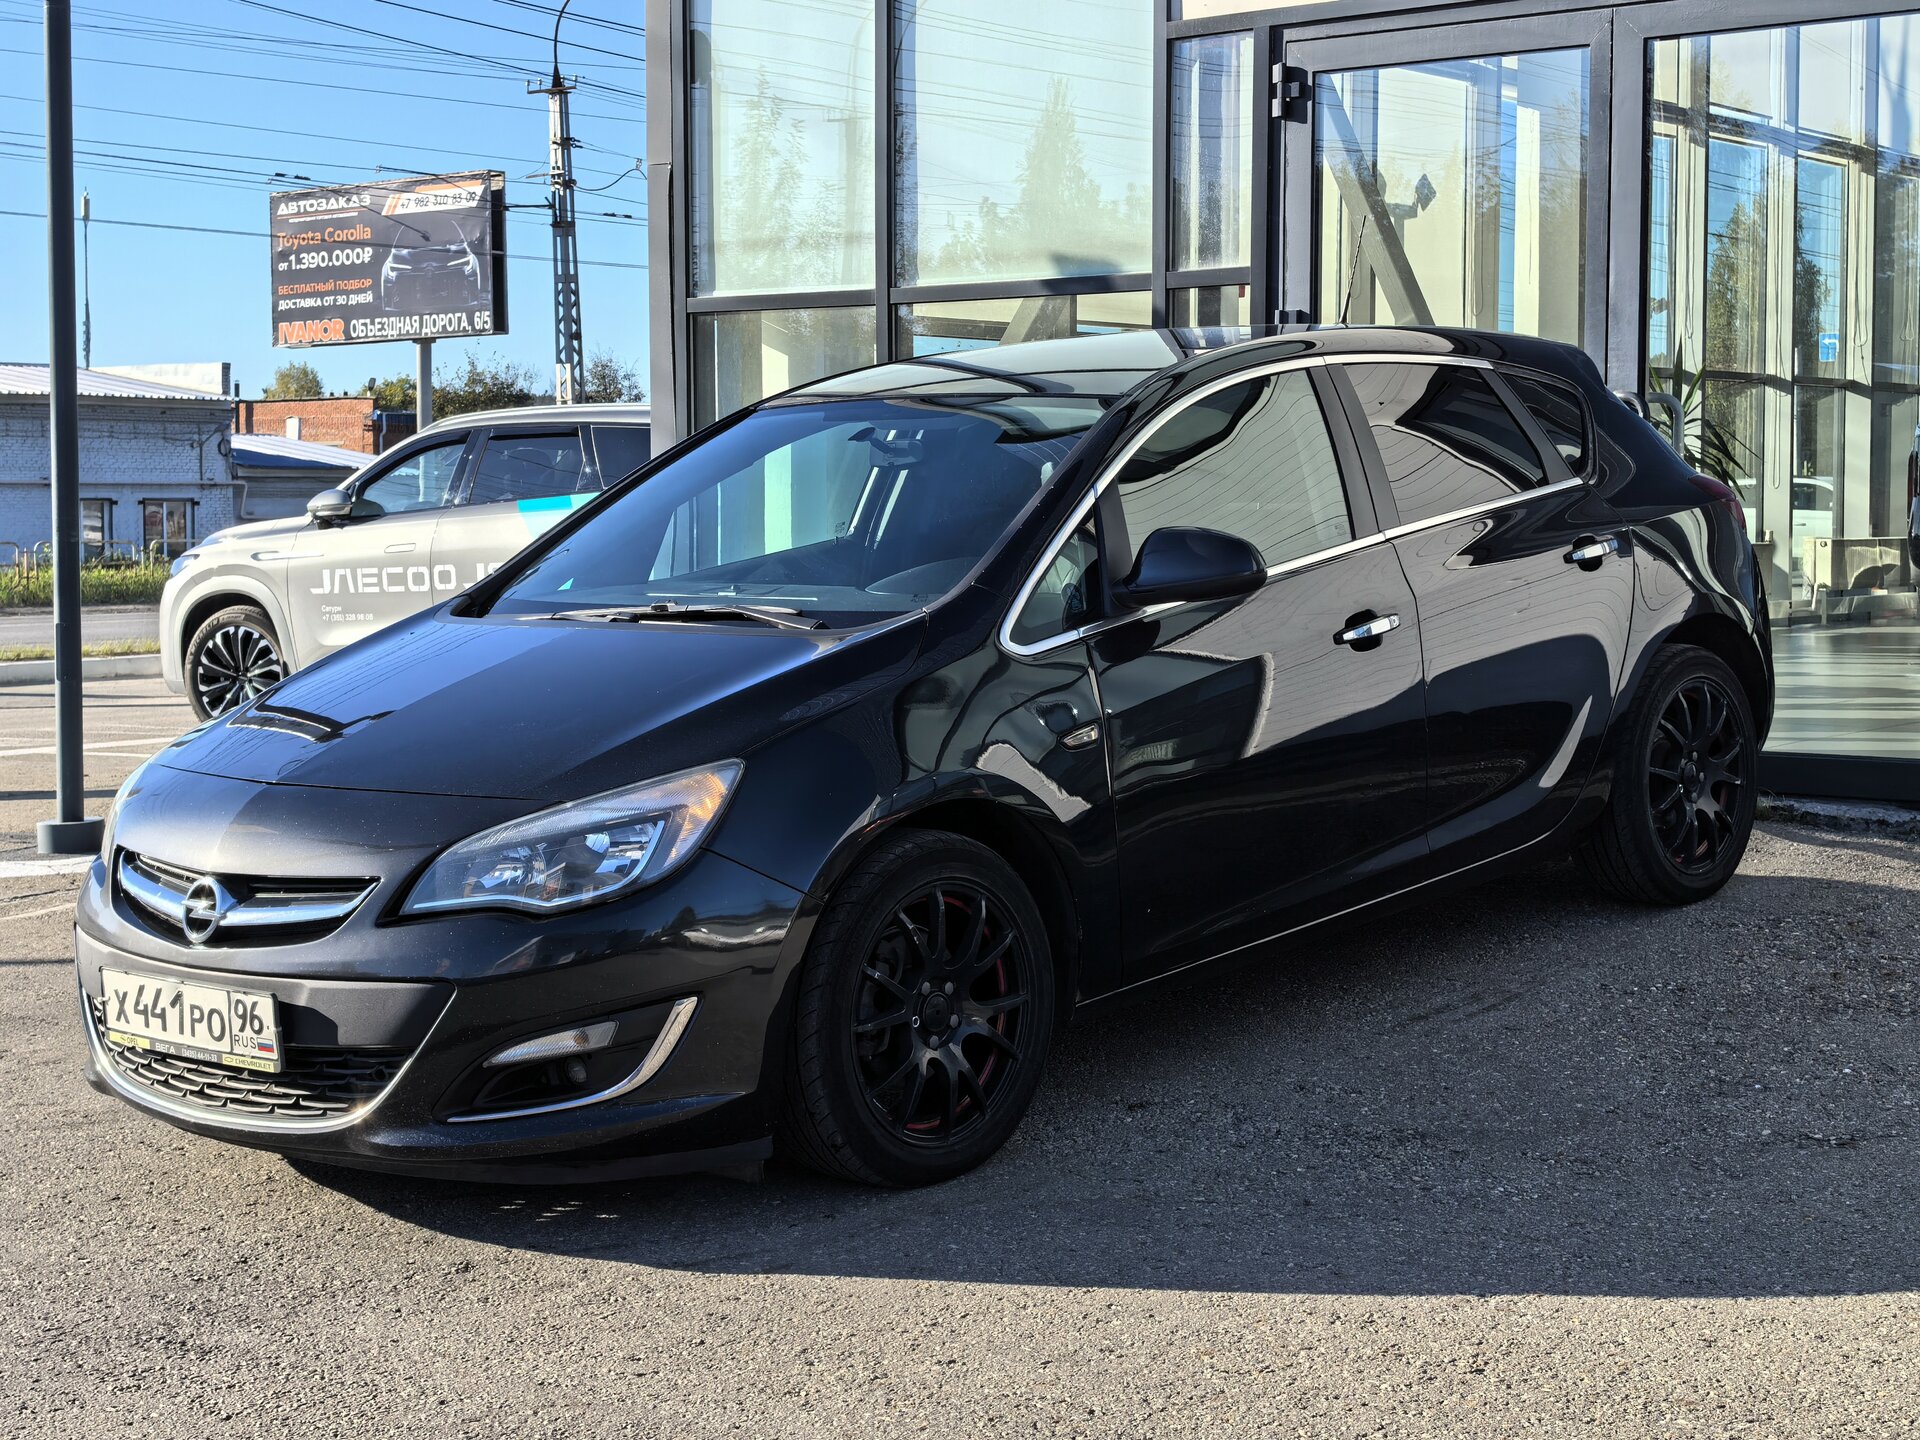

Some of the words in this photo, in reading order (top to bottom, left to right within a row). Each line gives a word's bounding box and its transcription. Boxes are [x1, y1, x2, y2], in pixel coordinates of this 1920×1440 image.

[277, 195, 371, 216] АВТОЗАКАЗ
[414, 197, 430, 208] 982
[432, 194, 448, 206] 310
[277, 231, 321, 250] Toyota
[324, 223, 372, 243] Corolla
[278, 280, 335, 296] БЕСПЛАТНЫЙ
[336, 278, 373, 292] ПОДБОР
[278, 297, 322, 311] ДОСТАВКА
[323, 295, 335, 306] ОТ
[336, 295, 347, 305] 30
[348, 290, 373, 306] ДНЕЙ
[278, 318, 345, 344] IVANOR
[350, 314, 420, 339] ОБЪЕЗДНАЯ
[422, 312, 472, 337] ДОРОГА,
[474, 310, 491, 330] 6/5
[309, 564, 457, 595] JAECOO
[127, 1036, 139, 1046] OPEL
[233, 1033, 257, 1051] RUS
[234, 1058, 272, 1070] CHEVROLET
